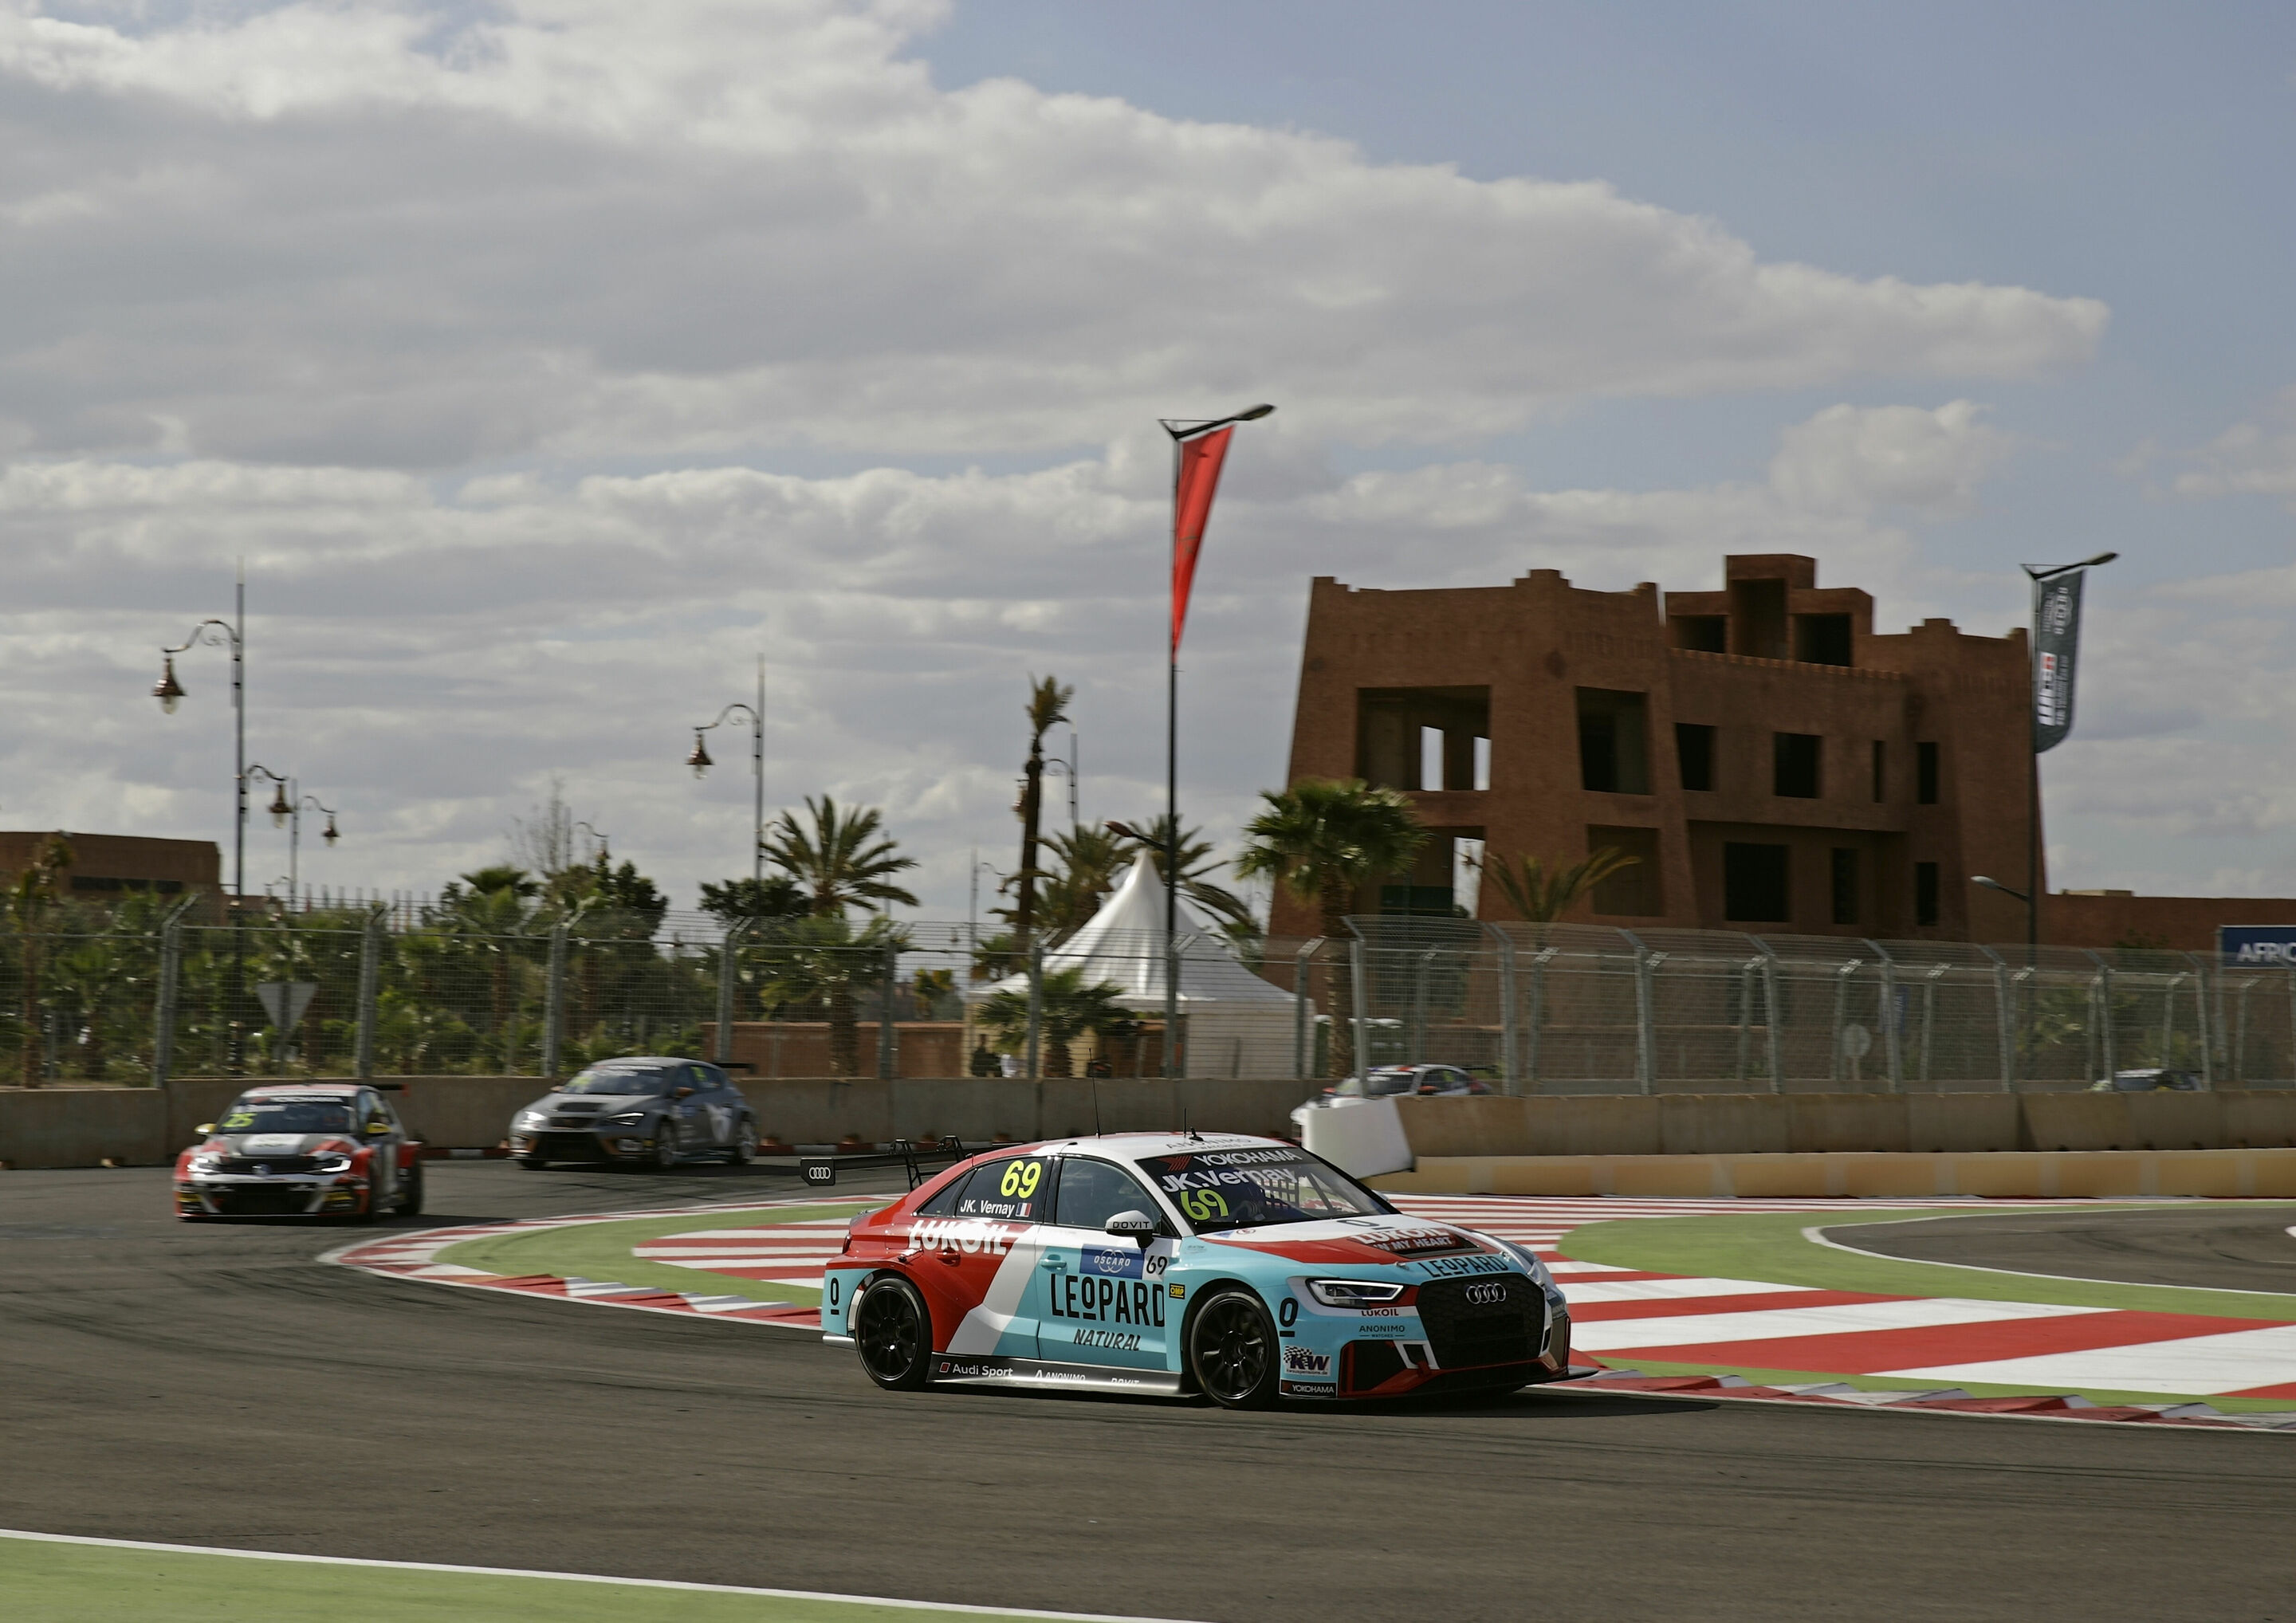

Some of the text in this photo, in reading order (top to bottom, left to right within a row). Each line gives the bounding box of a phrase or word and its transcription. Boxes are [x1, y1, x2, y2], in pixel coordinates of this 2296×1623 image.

[1193, 1150, 1303, 1167] YOKOHAMA
[1001, 1160, 1041, 1198] 69
[960, 1199, 1015, 1218] JK. Vernay
[1180, 1189, 1229, 1220] 69
[1112, 1220, 1150, 1229] DOVIT
[908, 1219, 1008, 1256] LUKOIL
[1350, 1227, 1449, 1244] LUKOIL
[1391, 1240, 1411, 1250] MY
[1413, 1236, 1453, 1248] HEART
[1094, 1255, 1131, 1267] OSCARO
[1146, 1255, 1168, 1275] 69
[1417, 1256, 1509, 1279] LEOPARD
[1170, 1286, 1185, 1295] OMP
[1051, 1272, 1165, 1327] LEOPARD
[1073, 1328, 1141, 1351] NATURAL
[952, 1363, 1013, 1377] Audi Sport
[1290, 1355, 1331, 1370] KW
[1045, 1371, 1086, 1381] ANONIMO
[1292, 1384, 1335, 1393] YOKOHAMA
